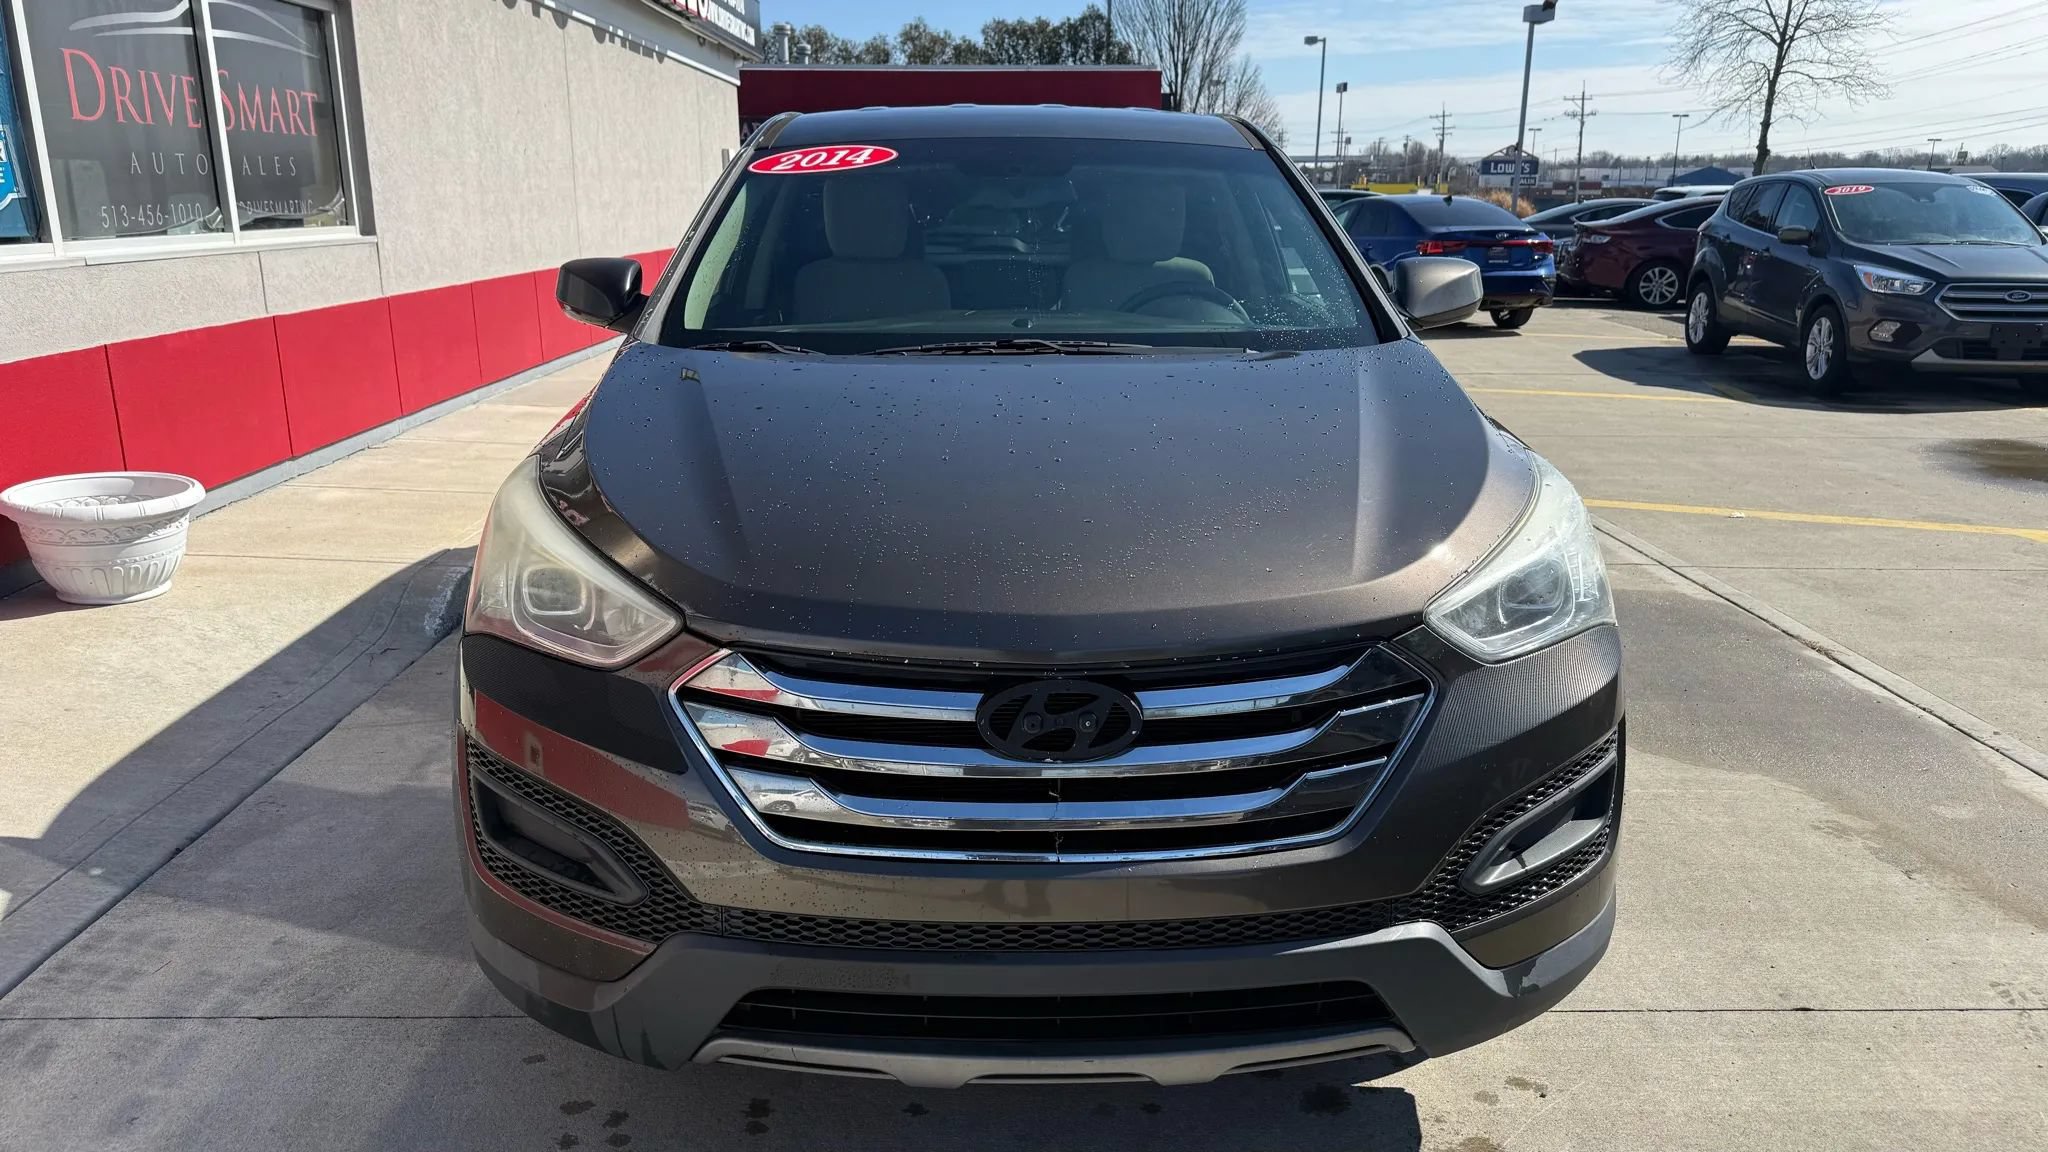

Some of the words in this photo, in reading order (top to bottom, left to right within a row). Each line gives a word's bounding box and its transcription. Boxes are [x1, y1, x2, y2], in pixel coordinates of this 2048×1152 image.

[60, 47, 202, 129] DRIVE
[217, 69, 319, 137] SMART
[131, 151, 209, 176] AUTO
[242, 155, 297, 177] ALES
[771, 148, 873, 171] 2014
[1490, 162, 1531, 174] LOW'S
[101, 203, 203, 229] 513-456-1010
